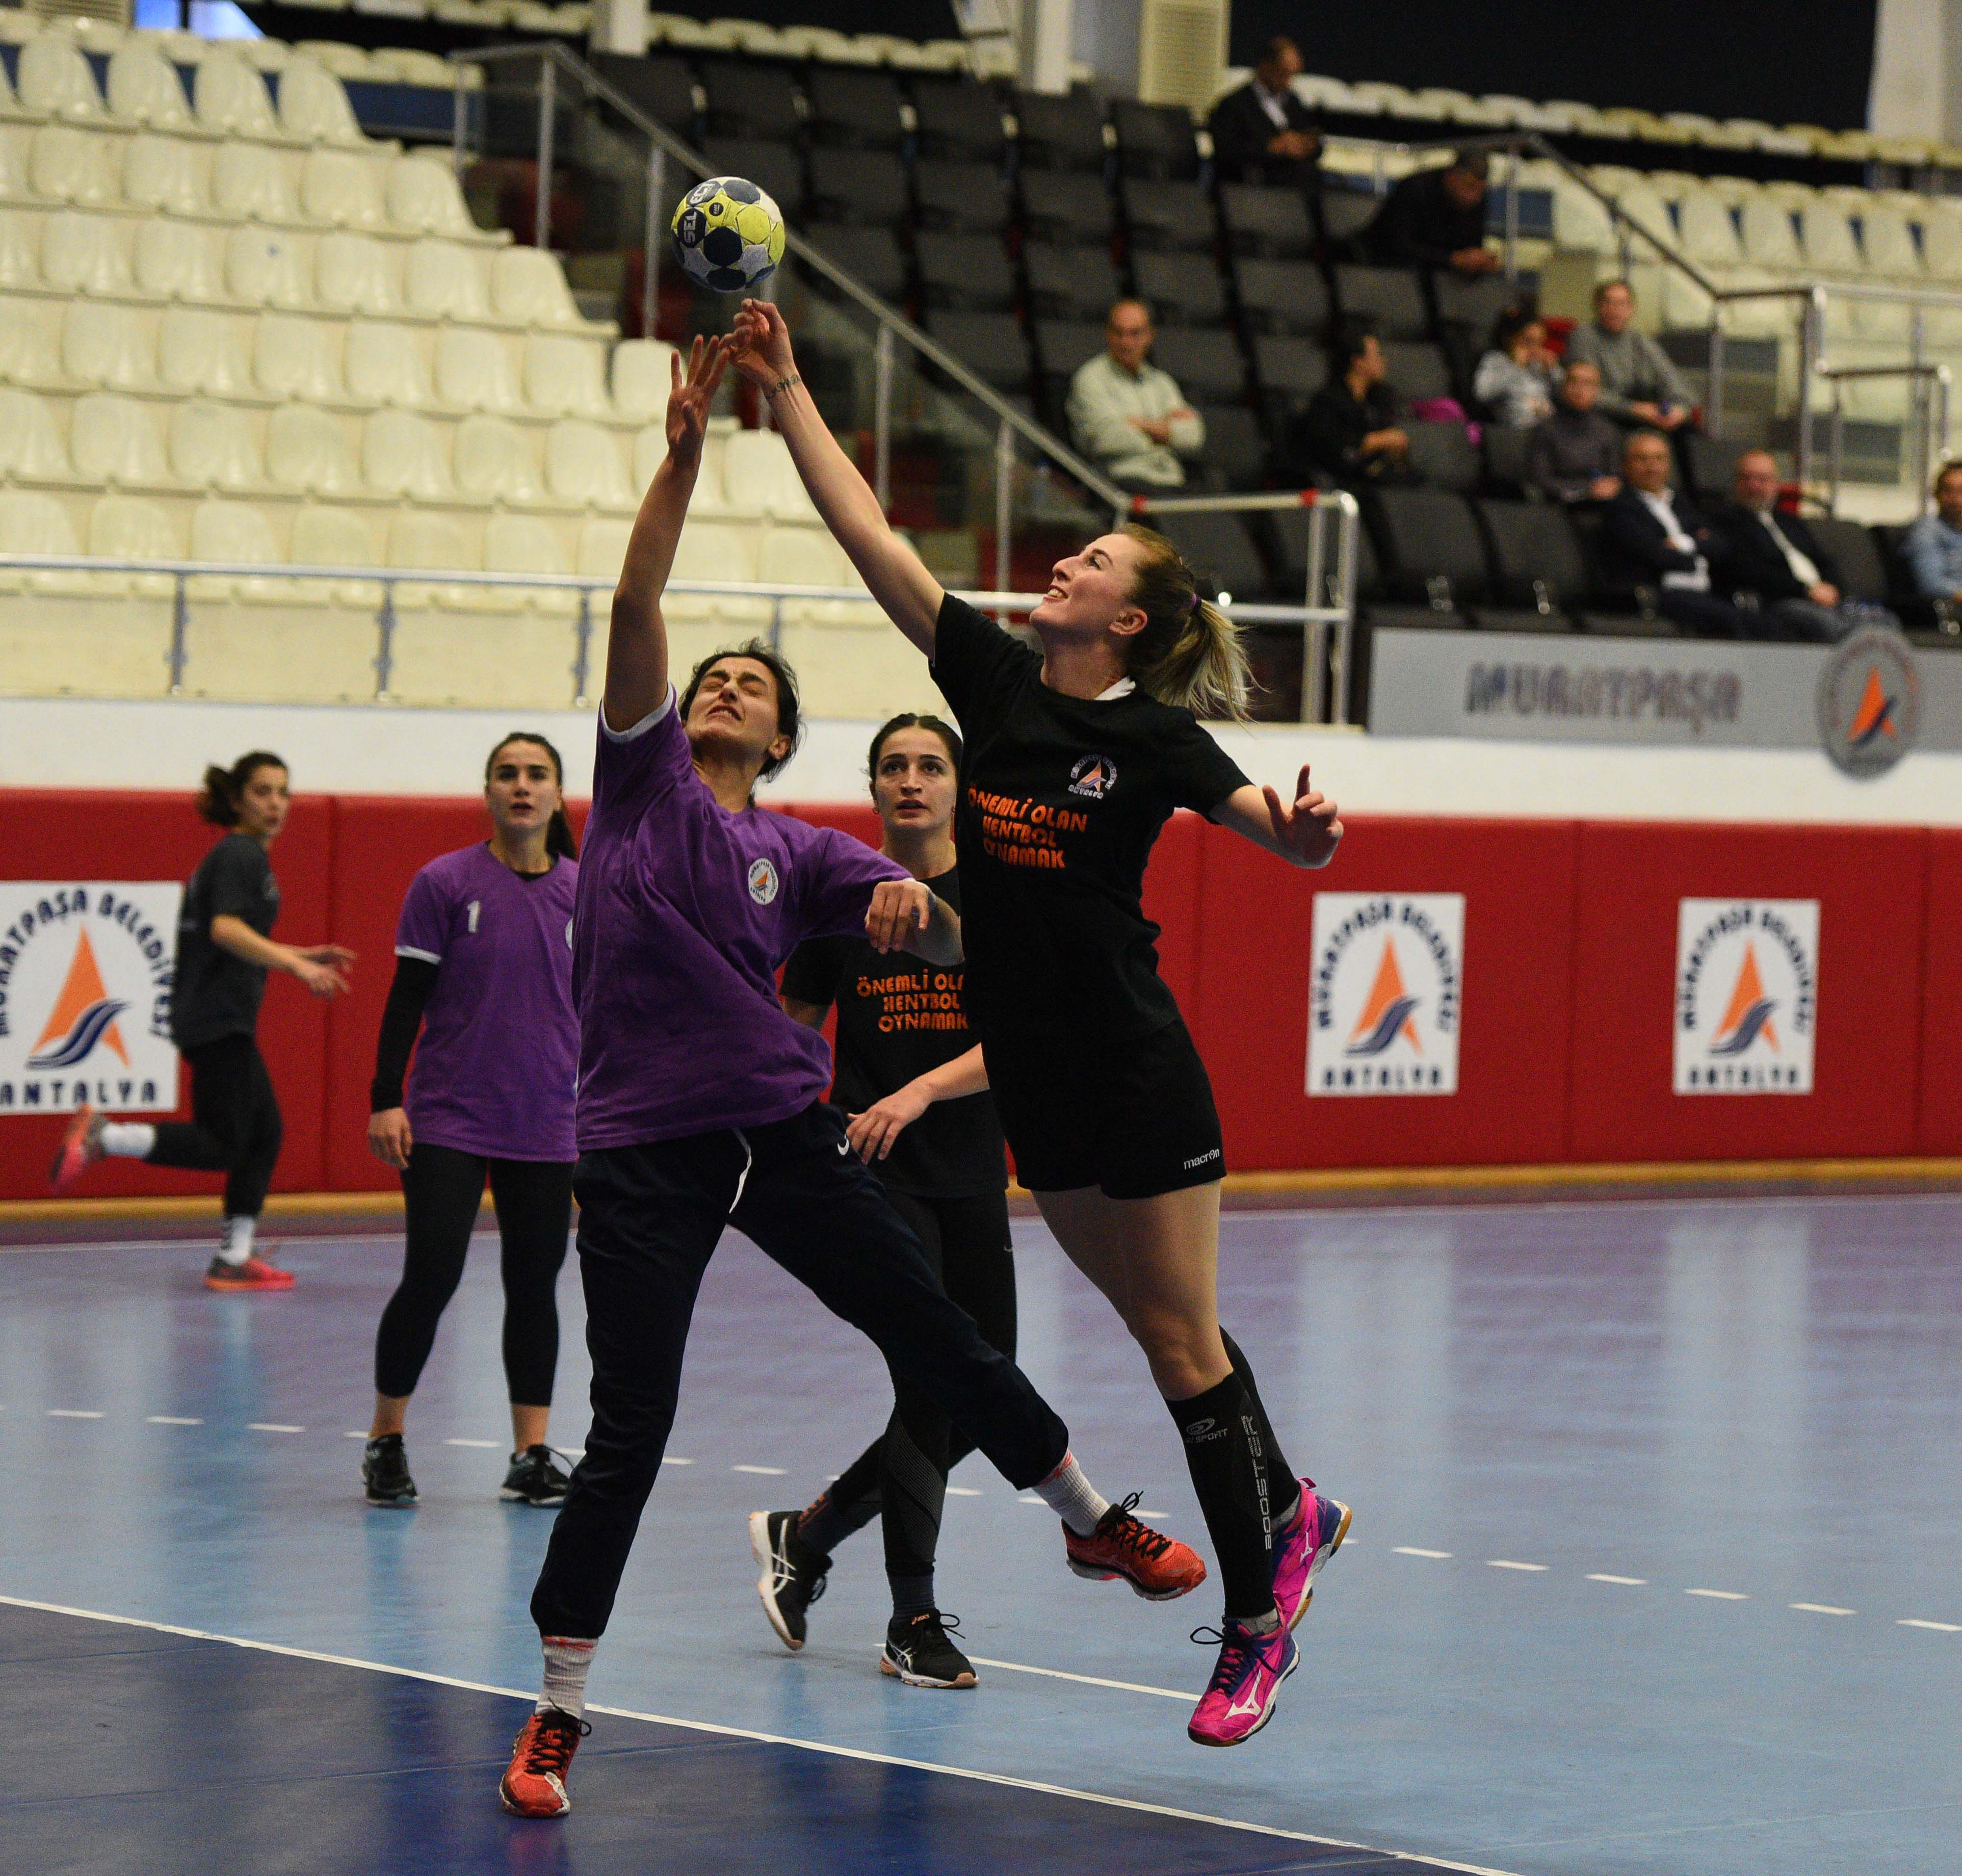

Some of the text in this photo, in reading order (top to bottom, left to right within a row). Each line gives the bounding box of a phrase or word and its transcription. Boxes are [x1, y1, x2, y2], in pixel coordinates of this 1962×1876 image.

[684, 211, 697, 245] SEL
[983, 815, 1057, 848] HENTBOL
[1031, 804, 1088, 832] OLAN
[467, 900, 481, 933] 1
[856, 968, 929, 998] ÖNEMLİ
[883, 992, 960, 1012] HENTBOL
[878, 1011, 969, 1032] OYNAMAK
[0, 1079, 158, 1106] ANTALYA
[1183, 1148, 1220, 1170] macron
[1241, 1415, 1272, 1550] BOOSTER
